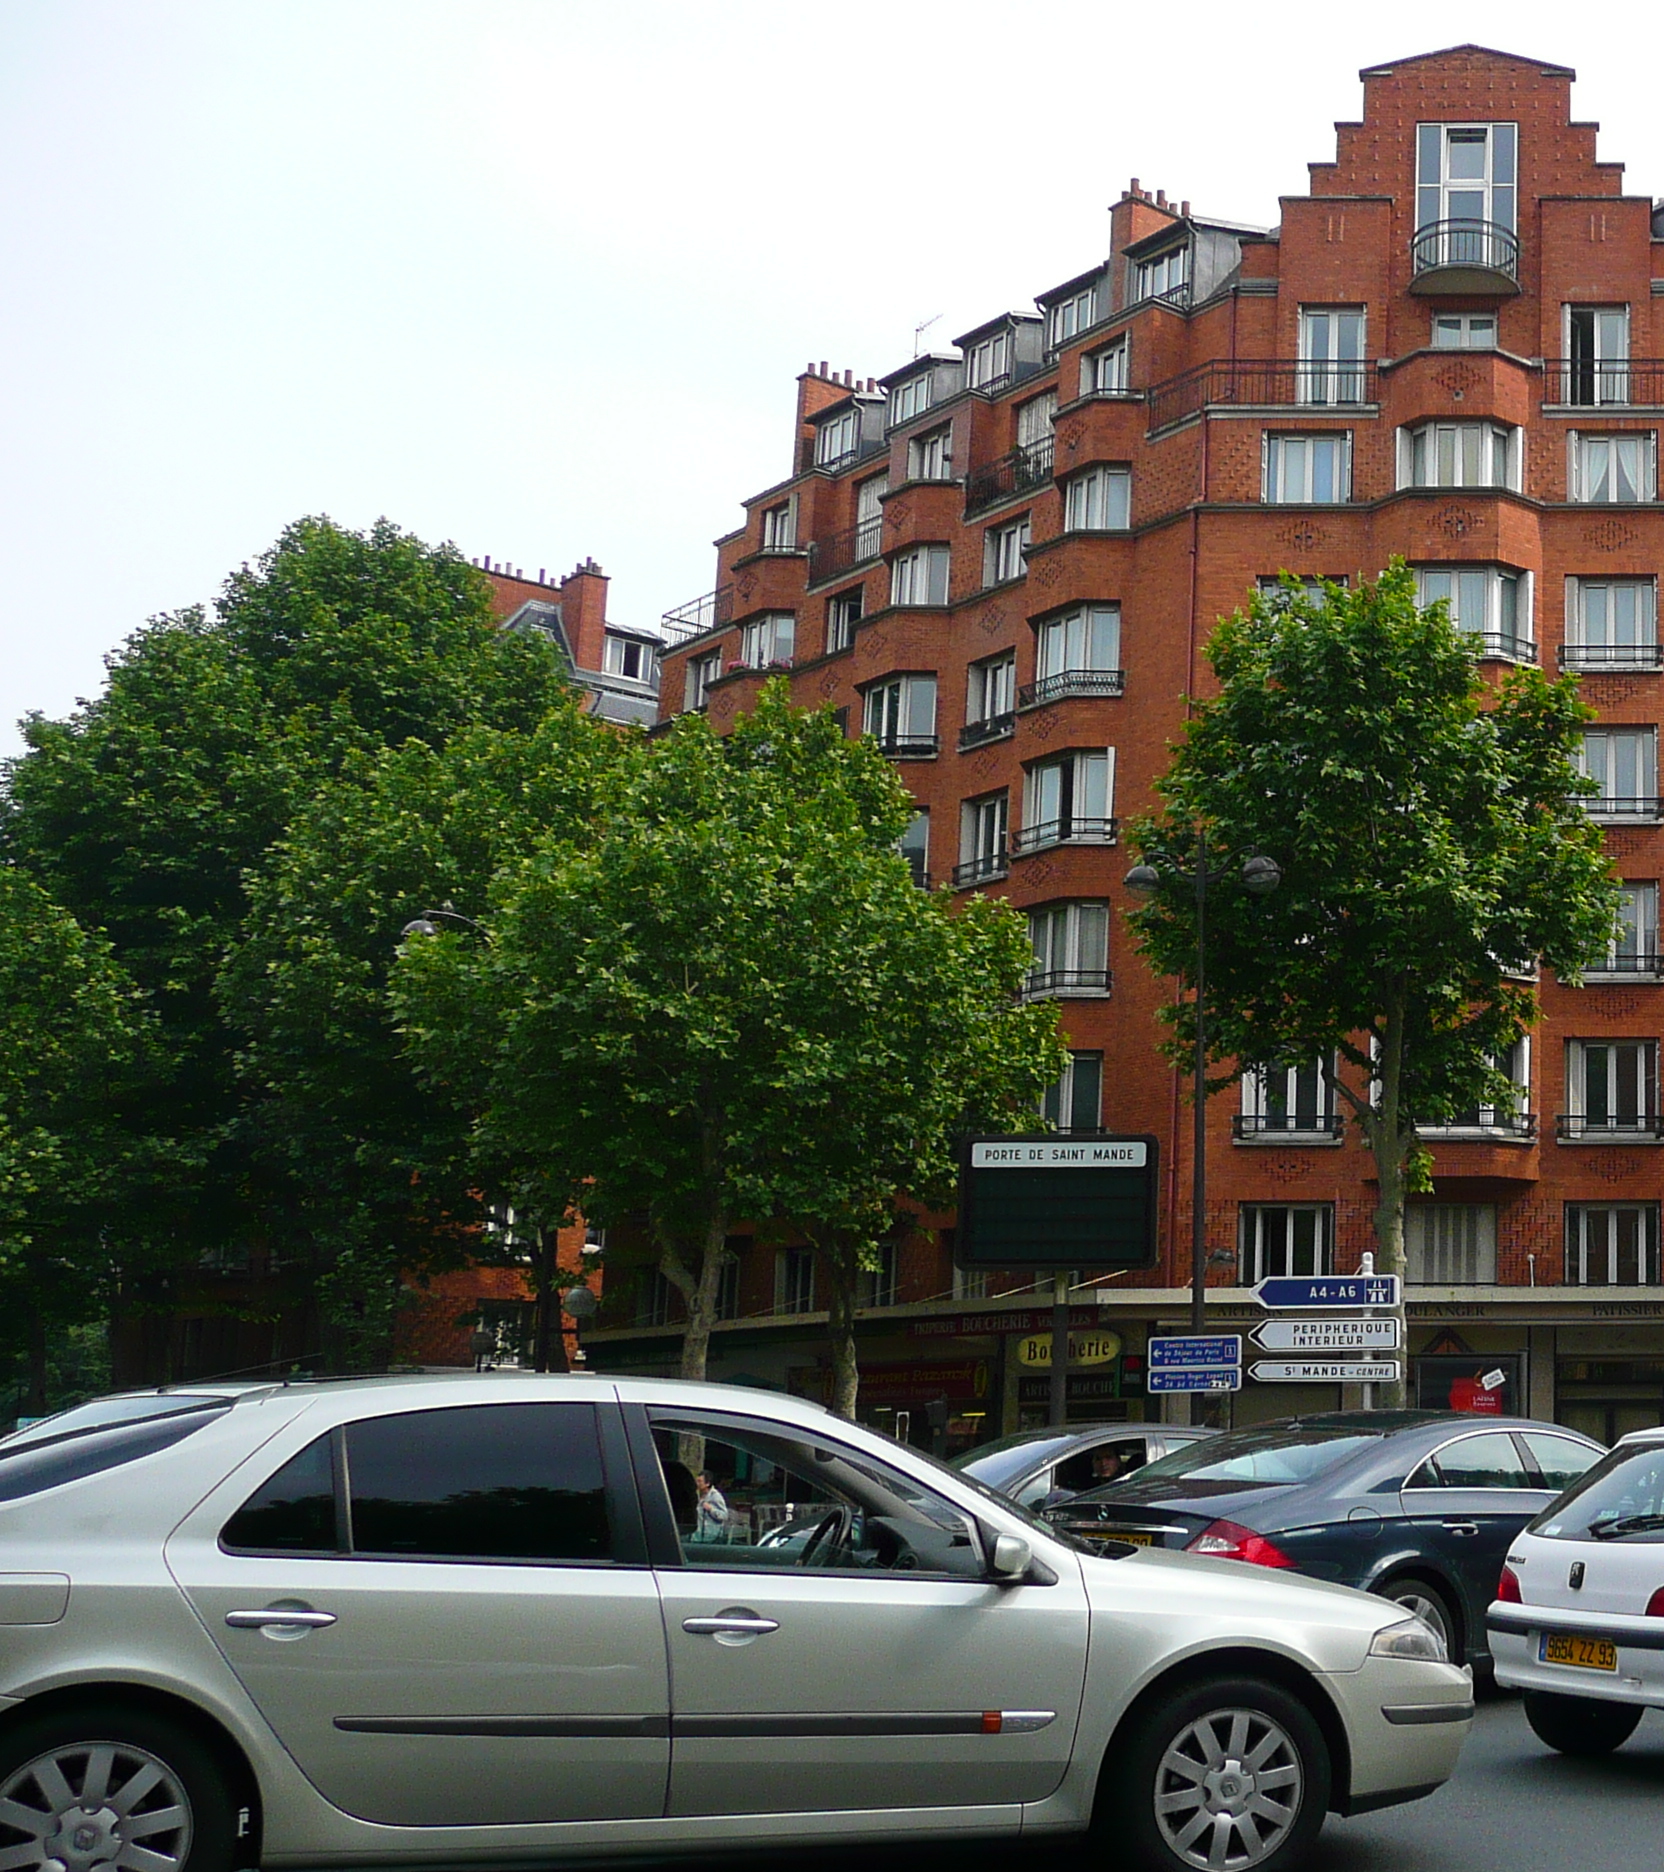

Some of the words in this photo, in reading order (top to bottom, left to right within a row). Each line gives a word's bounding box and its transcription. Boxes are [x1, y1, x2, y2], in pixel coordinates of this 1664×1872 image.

[984, 1149, 1022, 1161] PORTE
[1029, 1149, 1044, 1160] DE
[1051, 1148, 1086, 1161] SAINT
[1093, 1148, 1134, 1160] MANDE
[1217, 1305, 1283, 1317] ARTISAN
[1405, 1305, 1485, 1317] OULANGER
[1592, 1304, 1662, 1316] PATISSIER
[914, 1320, 957, 1336] TRIPERIE
[961, 1313, 1031, 1333] BOUCHERIE
[1293, 1323, 1391, 1335] PERIPHERIQUE
[1185, 1340, 1223, 1348] International
[1293, 1336, 1364, 1347] INTERIEUR
[1027, 1338, 1110, 1361] Boherie
[1302, 1366, 1346, 1376] MANDE
[1356, 1367, 1390, 1376] CENTRE
[1071, 1380, 1114, 1395] BOUCHE
[1547, 1636, 1574, 1661] 9654
[1598, 1641, 1615, 1666] 93
